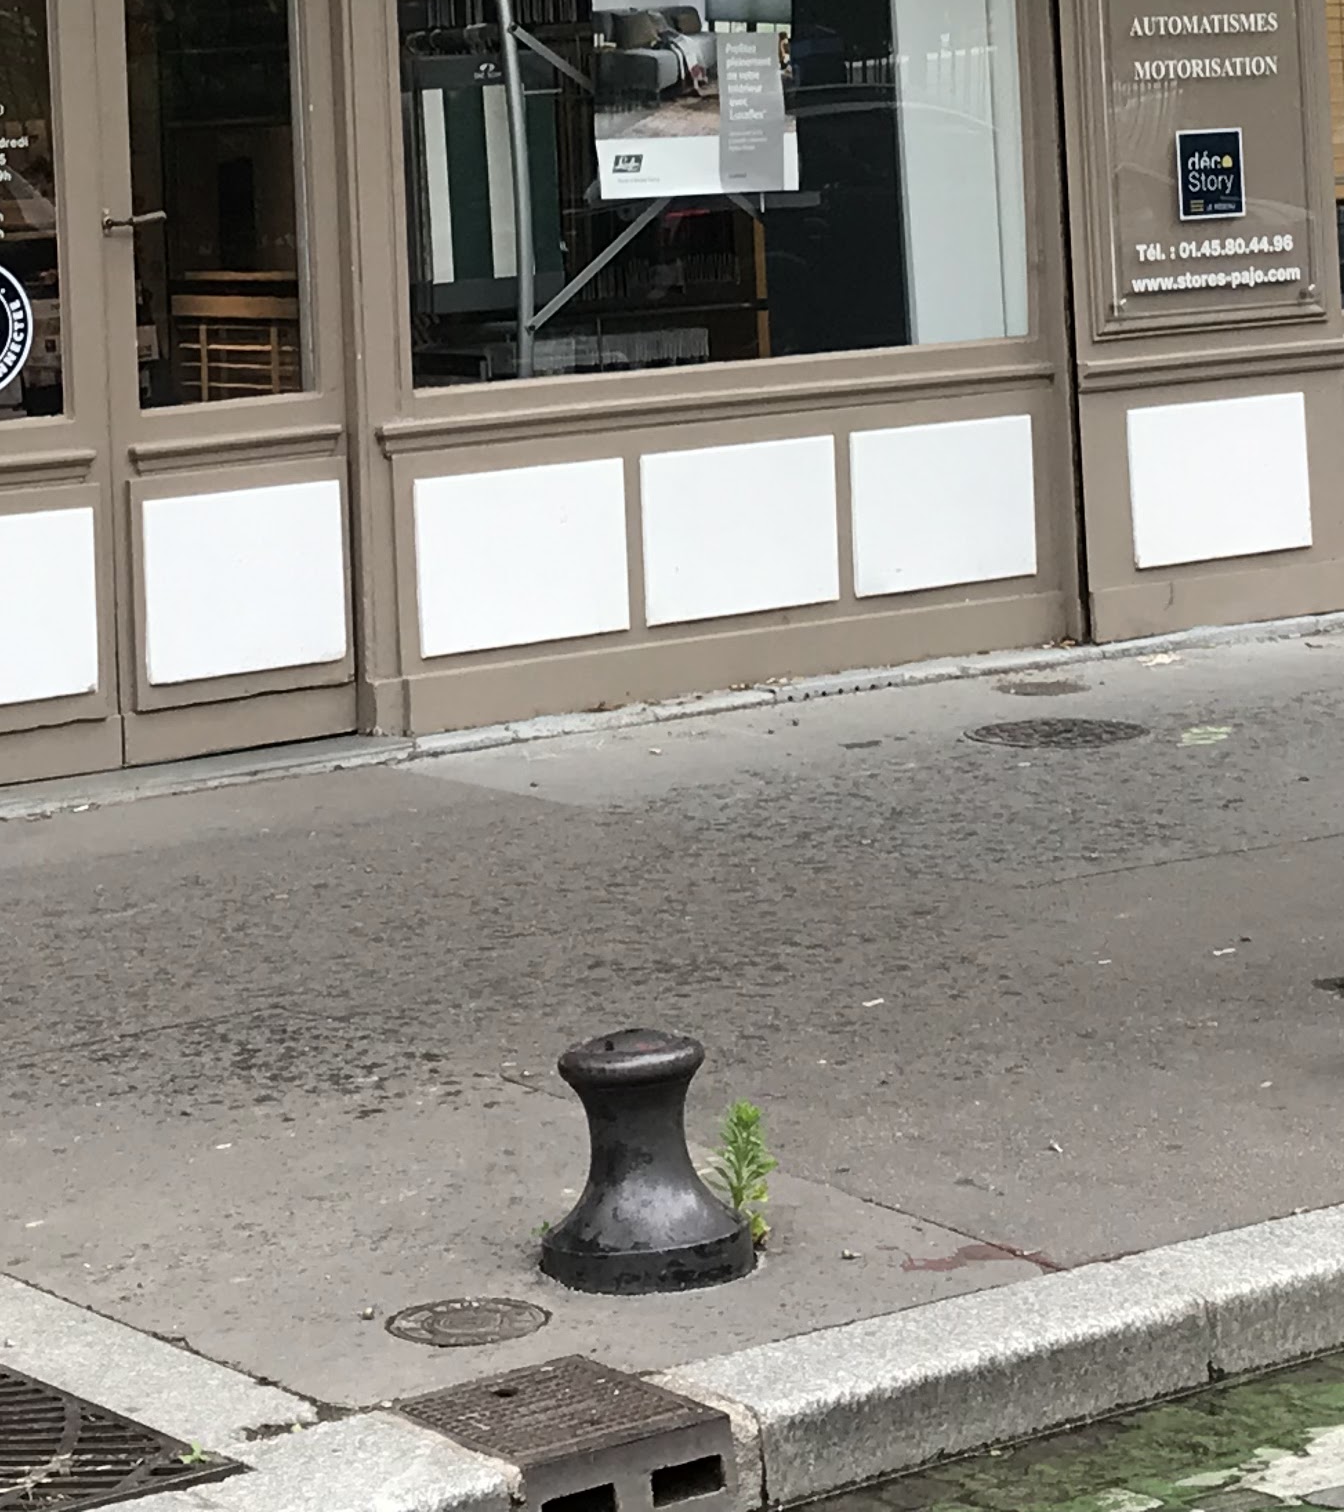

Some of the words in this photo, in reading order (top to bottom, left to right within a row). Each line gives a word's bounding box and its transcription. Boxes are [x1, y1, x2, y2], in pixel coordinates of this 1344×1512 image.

[1129, 12, 1279, 37] AUTOMATISMES
[1133, 56, 1278, 80] MOTORISATION
[1187, 171, 1234, 195] Story
[1135, 243, 1166, 262] Tél.
[1179, 234, 1294, 259] 01.45.80.44.96
[1131, 266, 1301, 294] www.stores-pajo.com
